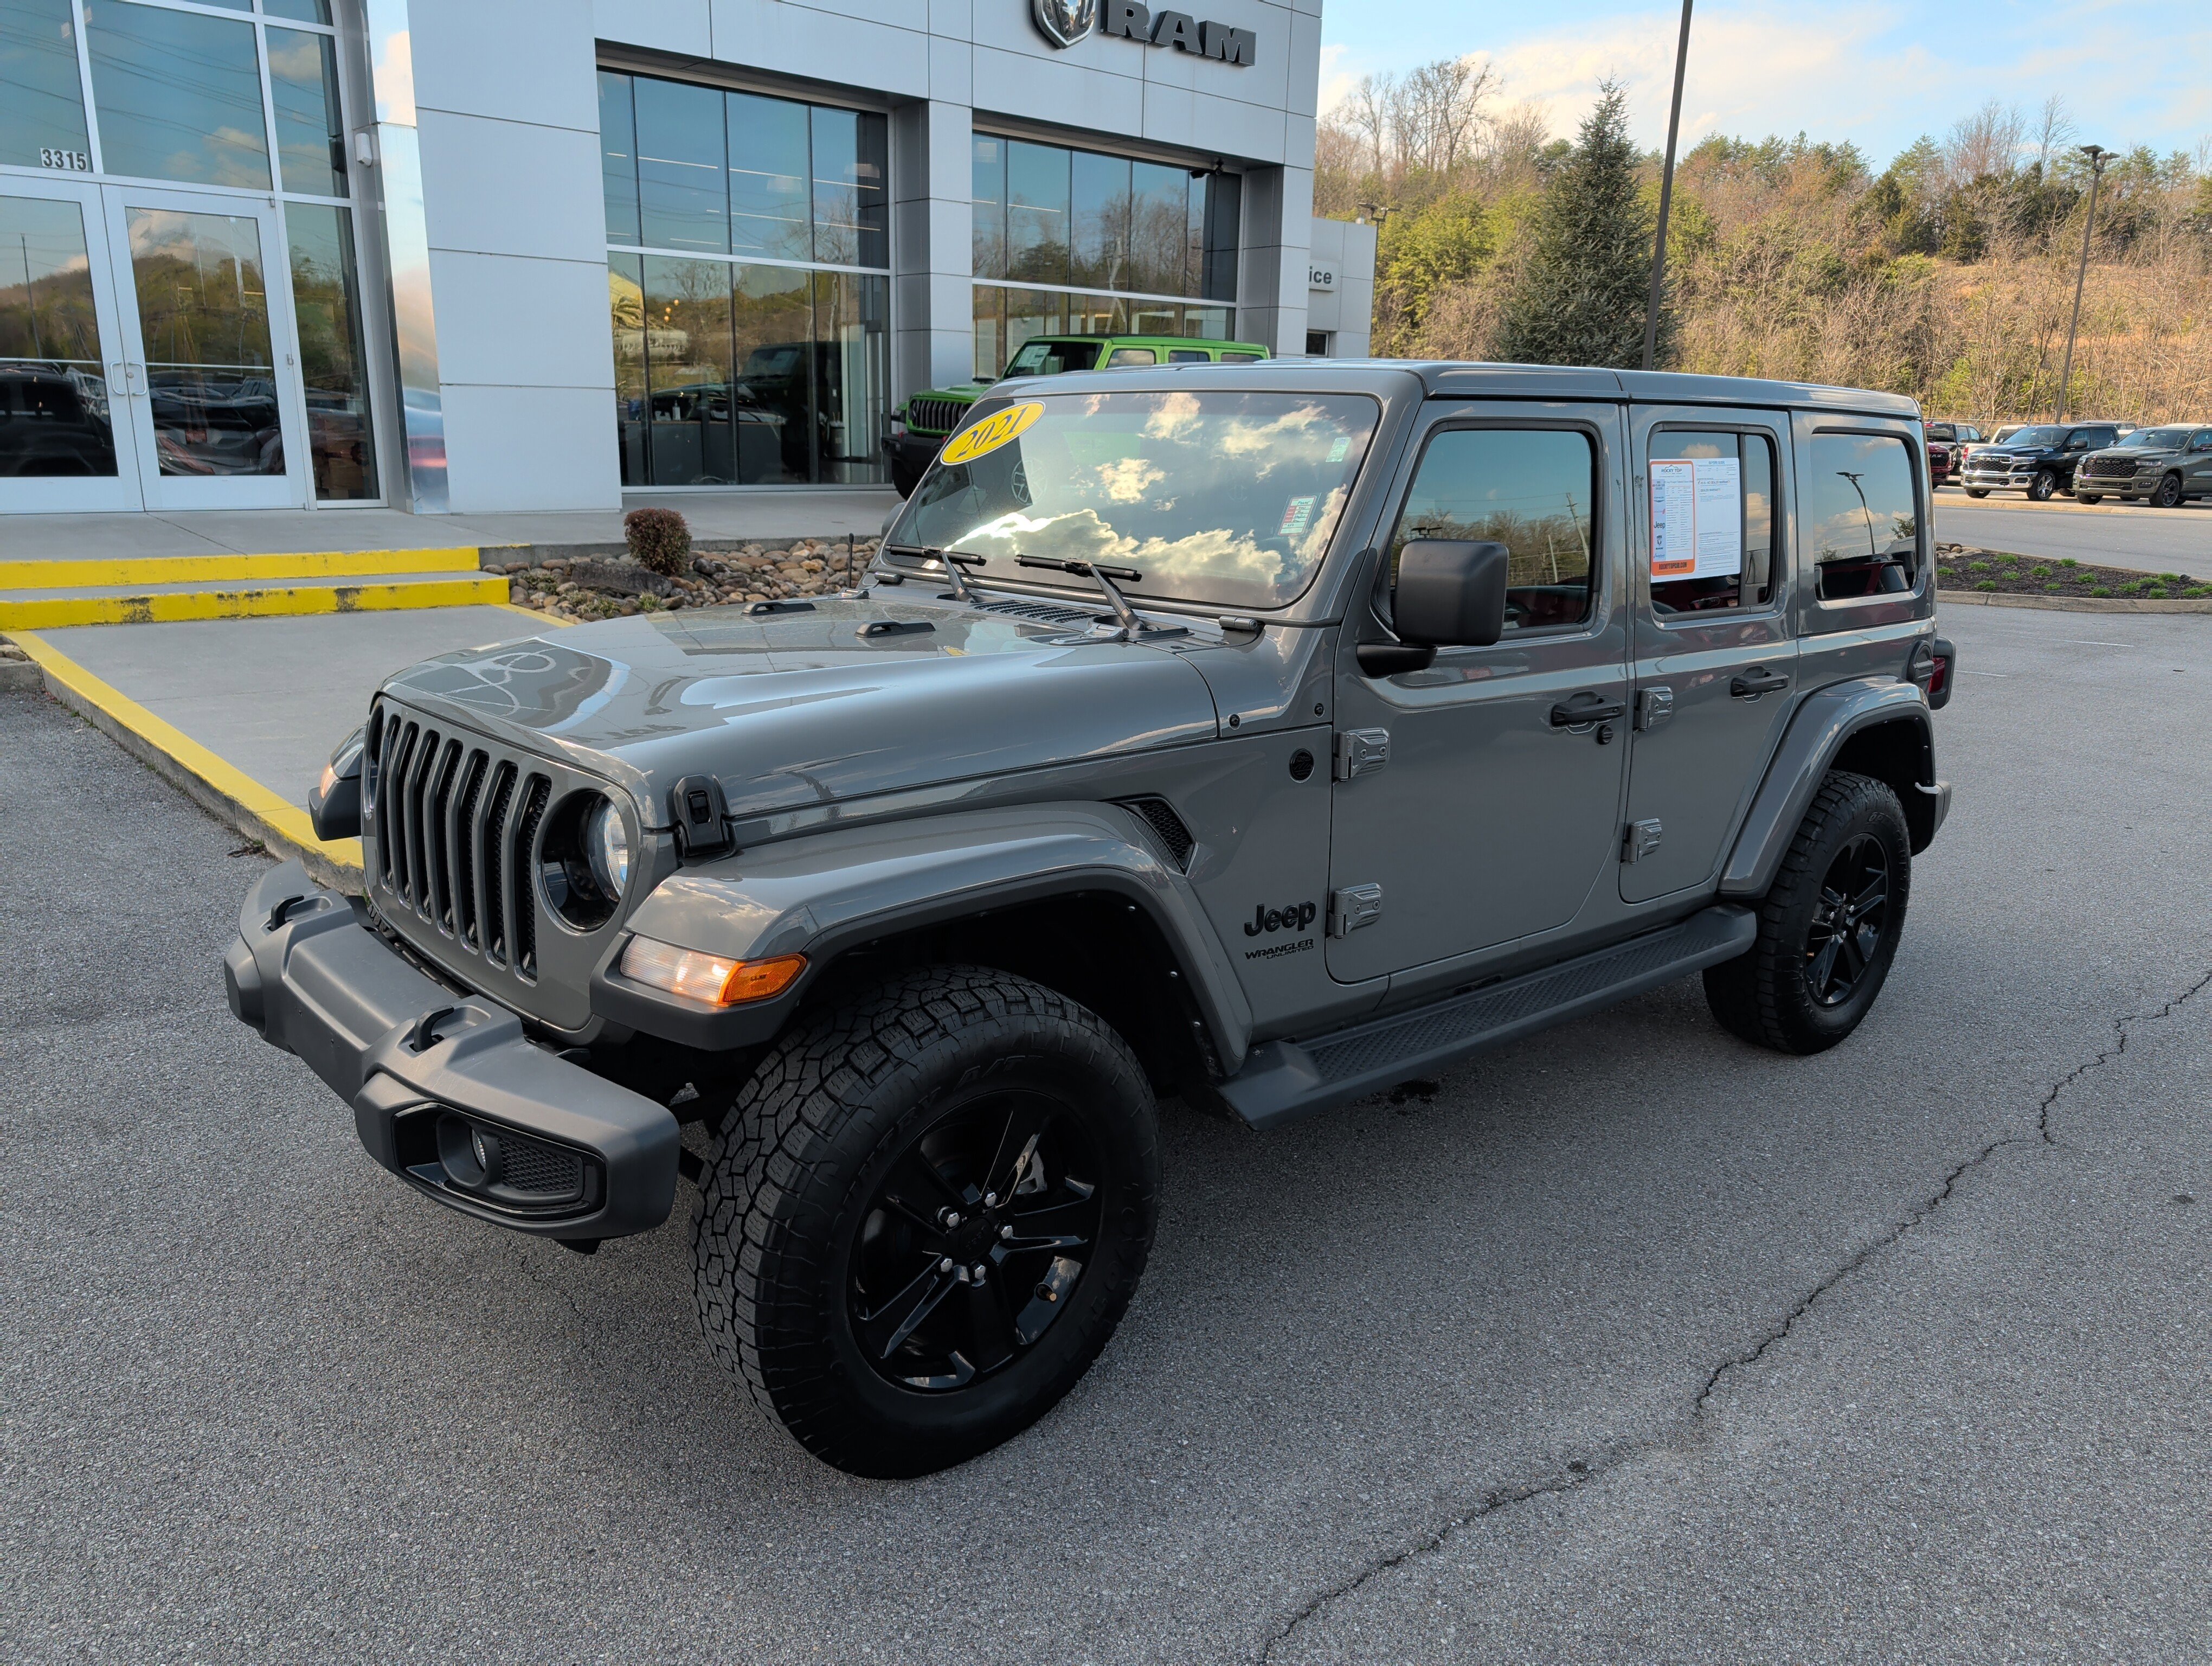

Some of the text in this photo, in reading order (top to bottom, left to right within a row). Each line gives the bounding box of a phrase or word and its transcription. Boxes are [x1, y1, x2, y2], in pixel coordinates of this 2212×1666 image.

[1101, 0, 1256, 66] RAM
[42, 149, 87, 170] 3315
[1309, 265, 1332, 284] ice
[955, 406, 1028, 459] 2021
[1654, 521, 1666, 529] Jeep
[1244, 901, 1316, 937] Jeep
[1245, 938, 1314, 960] WRANGLER
[1266, 945, 1314, 959] UNLIMITED
